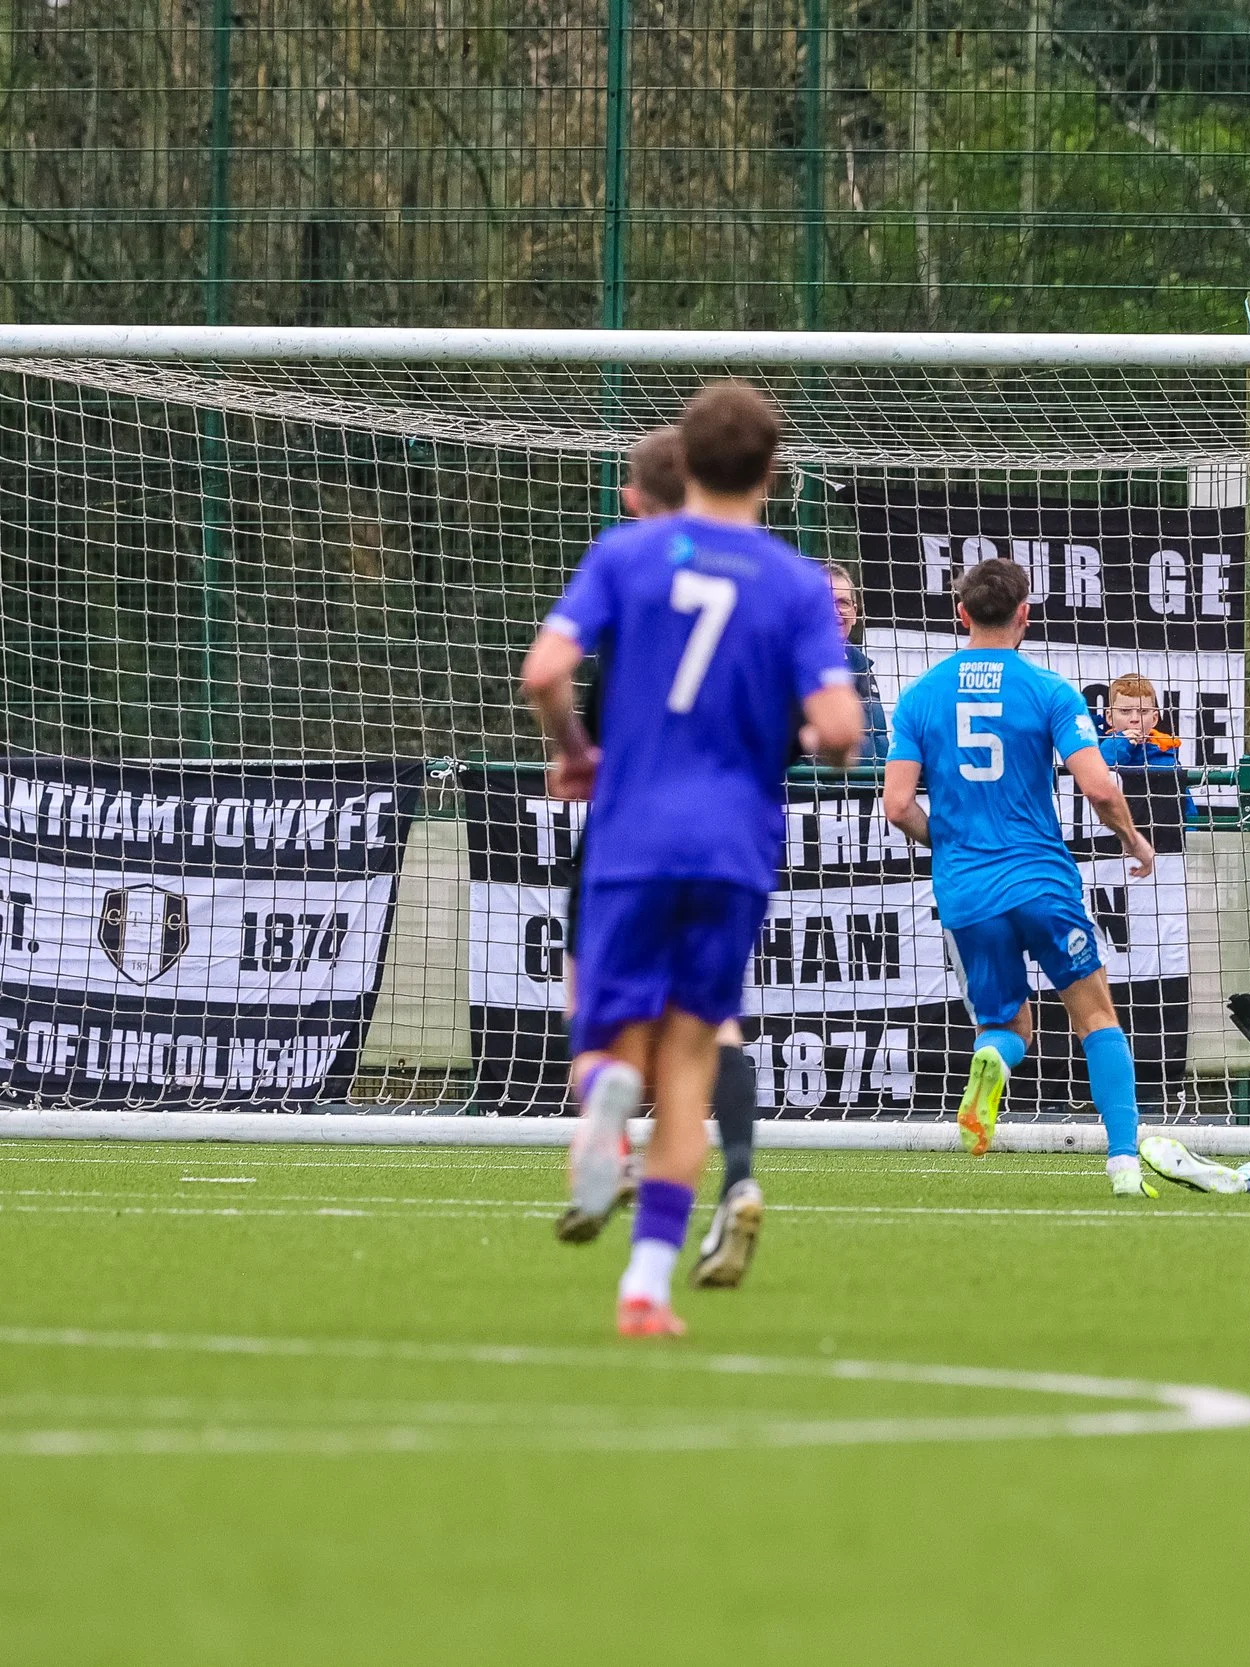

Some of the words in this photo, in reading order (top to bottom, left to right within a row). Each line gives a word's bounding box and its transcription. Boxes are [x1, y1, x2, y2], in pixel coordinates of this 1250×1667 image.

[668, 569, 737, 714] 7
[959, 662, 1004, 673] SPORTING
[958, 673, 1003, 689] TOUCH
[956, 702, 1004, 782] 5
[0, 773, 181, 845] NTHAM
[190, 797, 333, 850] TOWN
[239, 911, 349, 973] 1874
[26, 1020, 80, 1075] OF
[742, 1028, 915, 1107] 1874
